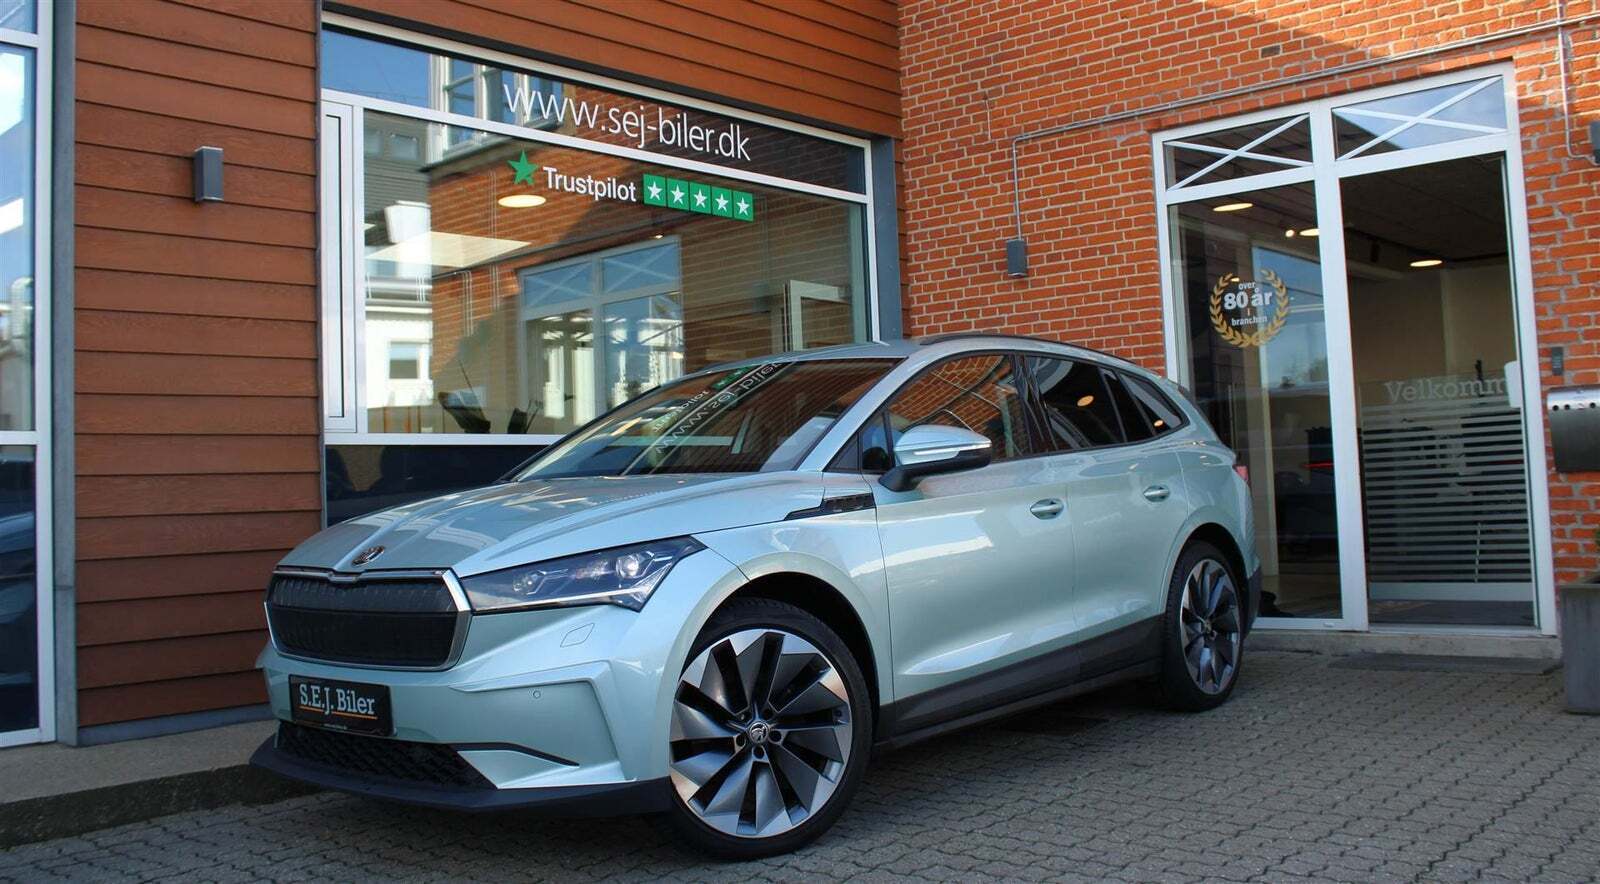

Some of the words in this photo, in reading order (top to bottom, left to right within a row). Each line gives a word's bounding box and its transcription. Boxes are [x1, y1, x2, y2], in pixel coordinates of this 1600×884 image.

[503, 84, 751, 161] www.sej-biler.dk
[543, 166, 637, 202] Trustpilot
[1223, 291, 1249, 310] 80
[1251, 287, 1273, 307] år
[1238, 281, 1256, 290] over
[1231, 315, 1268, 326] branchen
[299, 683, 334, 715] S.E.J.
[336, 688, 375, 715] Biler
